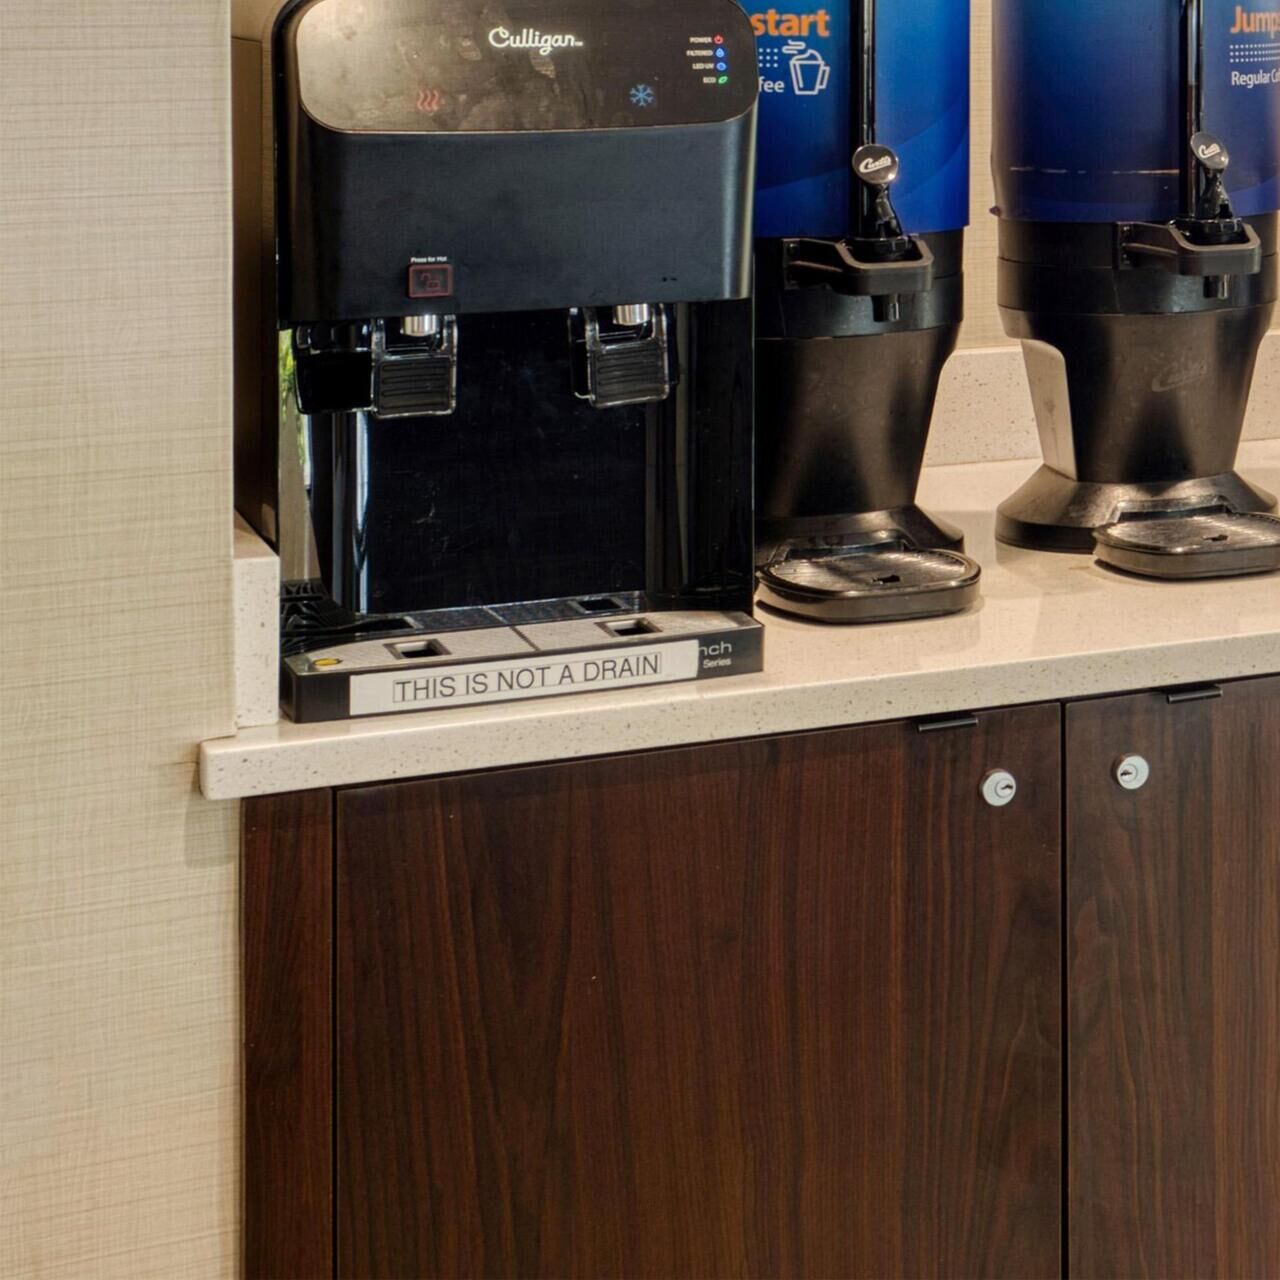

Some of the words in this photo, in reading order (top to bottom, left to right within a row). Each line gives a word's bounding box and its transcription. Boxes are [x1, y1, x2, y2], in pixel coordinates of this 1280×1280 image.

[488, 26, 576, 56] Culligan
[1231, 69, 1270, 89] Regular
[703, 658, 732, 668] Series
[396, 676, 456, 702] THIS
[465, 672, 489, 695] IS
[498, 666, 551, 691] NOT
[558, 664, 575, 686] A
[583, 654, 660, 683] DRAIN
